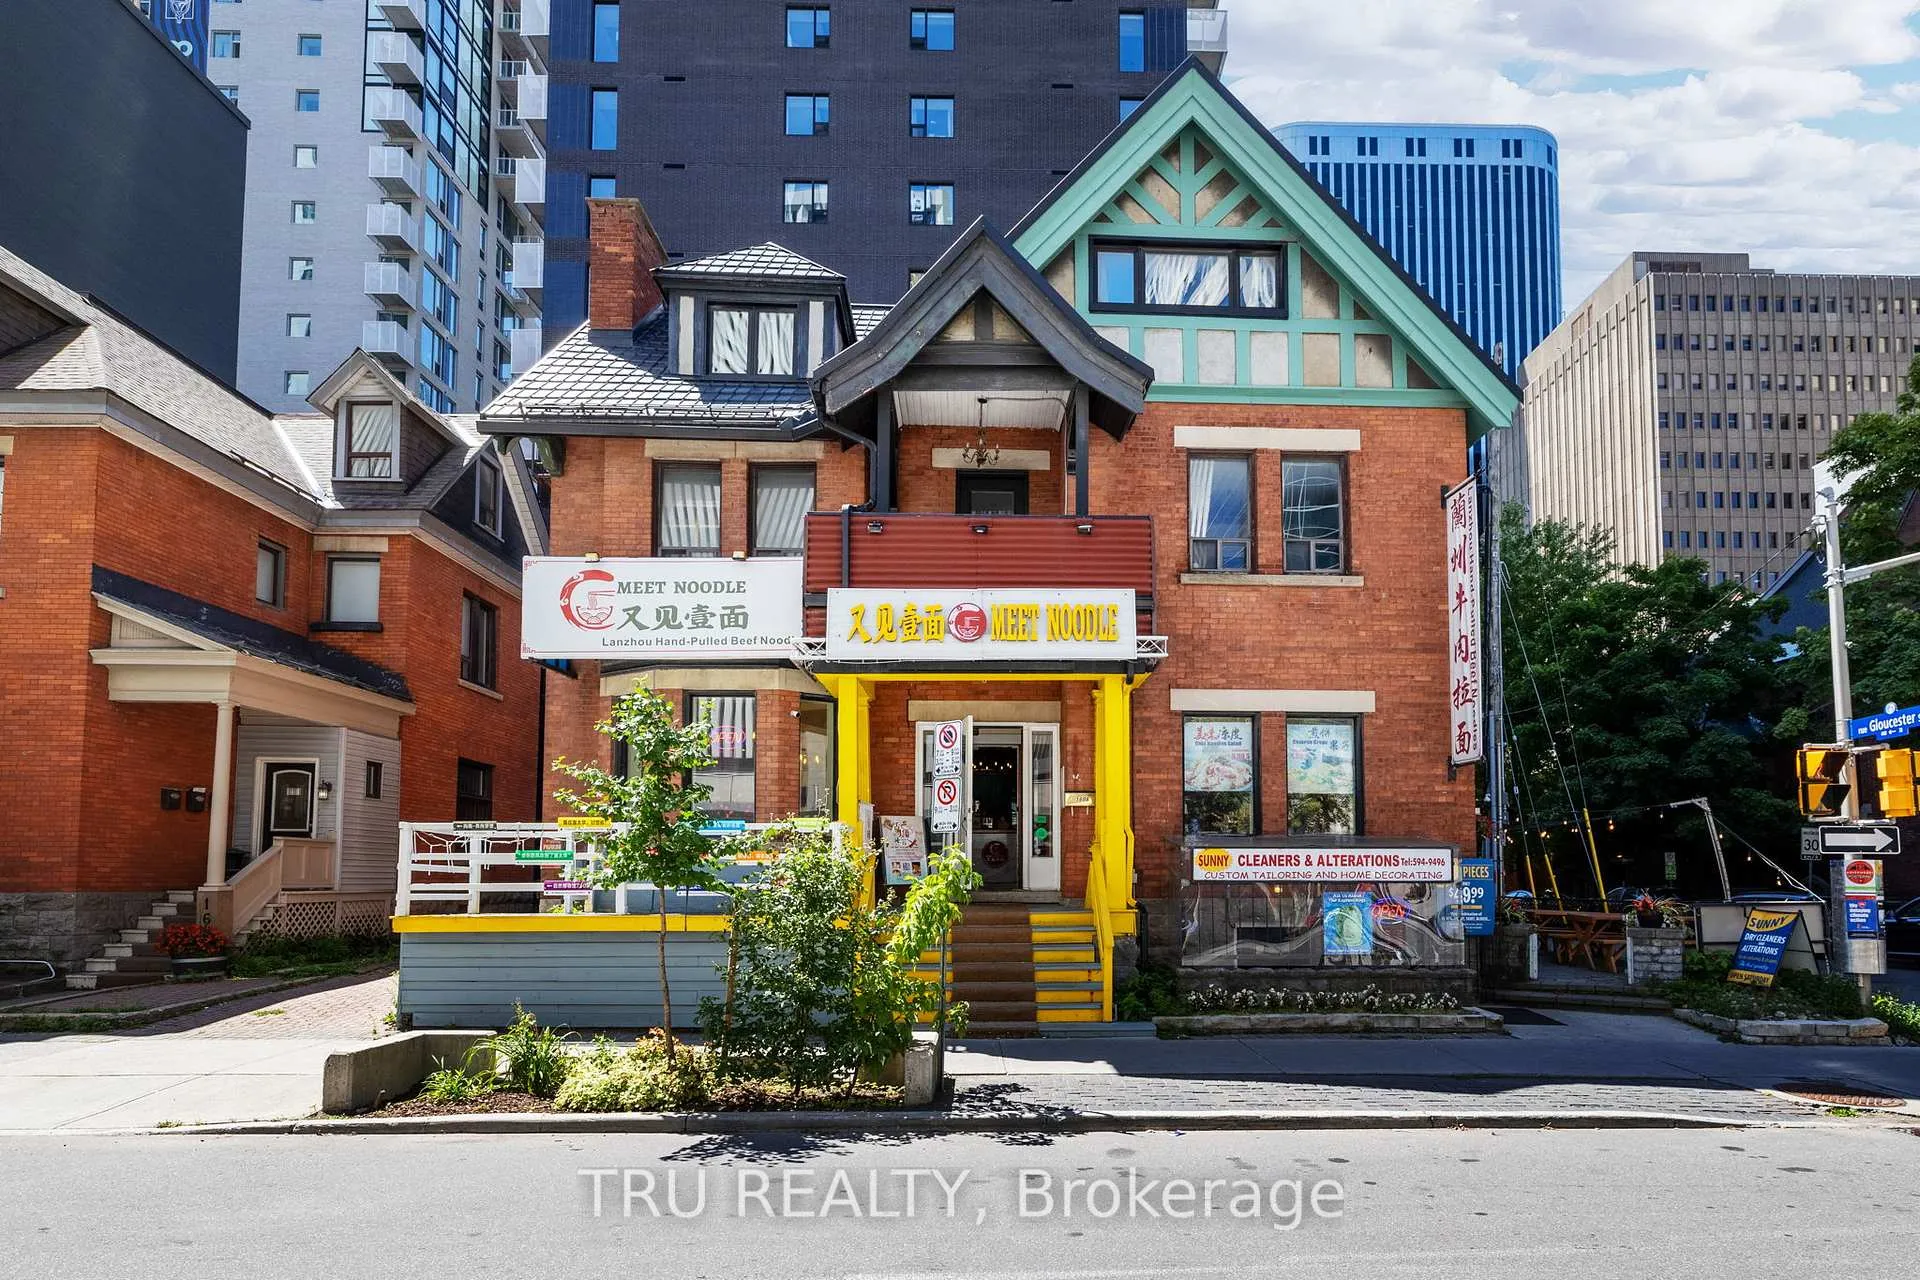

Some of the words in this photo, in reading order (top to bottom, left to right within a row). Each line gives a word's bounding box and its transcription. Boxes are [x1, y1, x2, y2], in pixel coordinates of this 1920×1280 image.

[617, 581, 666, 594] MEET
[674, 581, 746, 594] NOODLE
[617, 604, 749, 631] 又见壹面
[847, 602, 945, 644] 又见壹面
[991, 603, 1039, 642] MEET
[1046, 603, 1118, 642] NOODLE
[602, 637, 652, 646] Lanzhou
[656, 637, 728, 647] Hand-Pulled
[731, 636, 758, 646] Beef
[760, 635, 795, 645] Nood
[1869, 712, 1916, 732] Gloucester
[1804, 839, 1819, 851] 30
[1198, 854, 1229, 867] SUNNY
[1238, 854, 1300, 867] CLEANERS
[1304, 854, 1313, 867] &
[1317, 854, 1400, 867] ALTERATIONS
[1401, 858, 1446, 867] Tel:594-9496
[1204, 871, 1249, 880] CUSTOM
[1252, 871, 1312, 880] TAILORING
[1315, 871, 1338, 880] AND
[1341, 871, 1371, 880] HOME
[1374, 871, 1443, 880] DECORATING
[1463, 866, 1489, 878] PIECES
[1749, 917, 1787, 929] SUNNY
[1744, 932, 1756, 941] DRY
[1756, 934, 1787, 944] CLEANERS
[1741, 945, 1779, 955] ALTERATIONS
